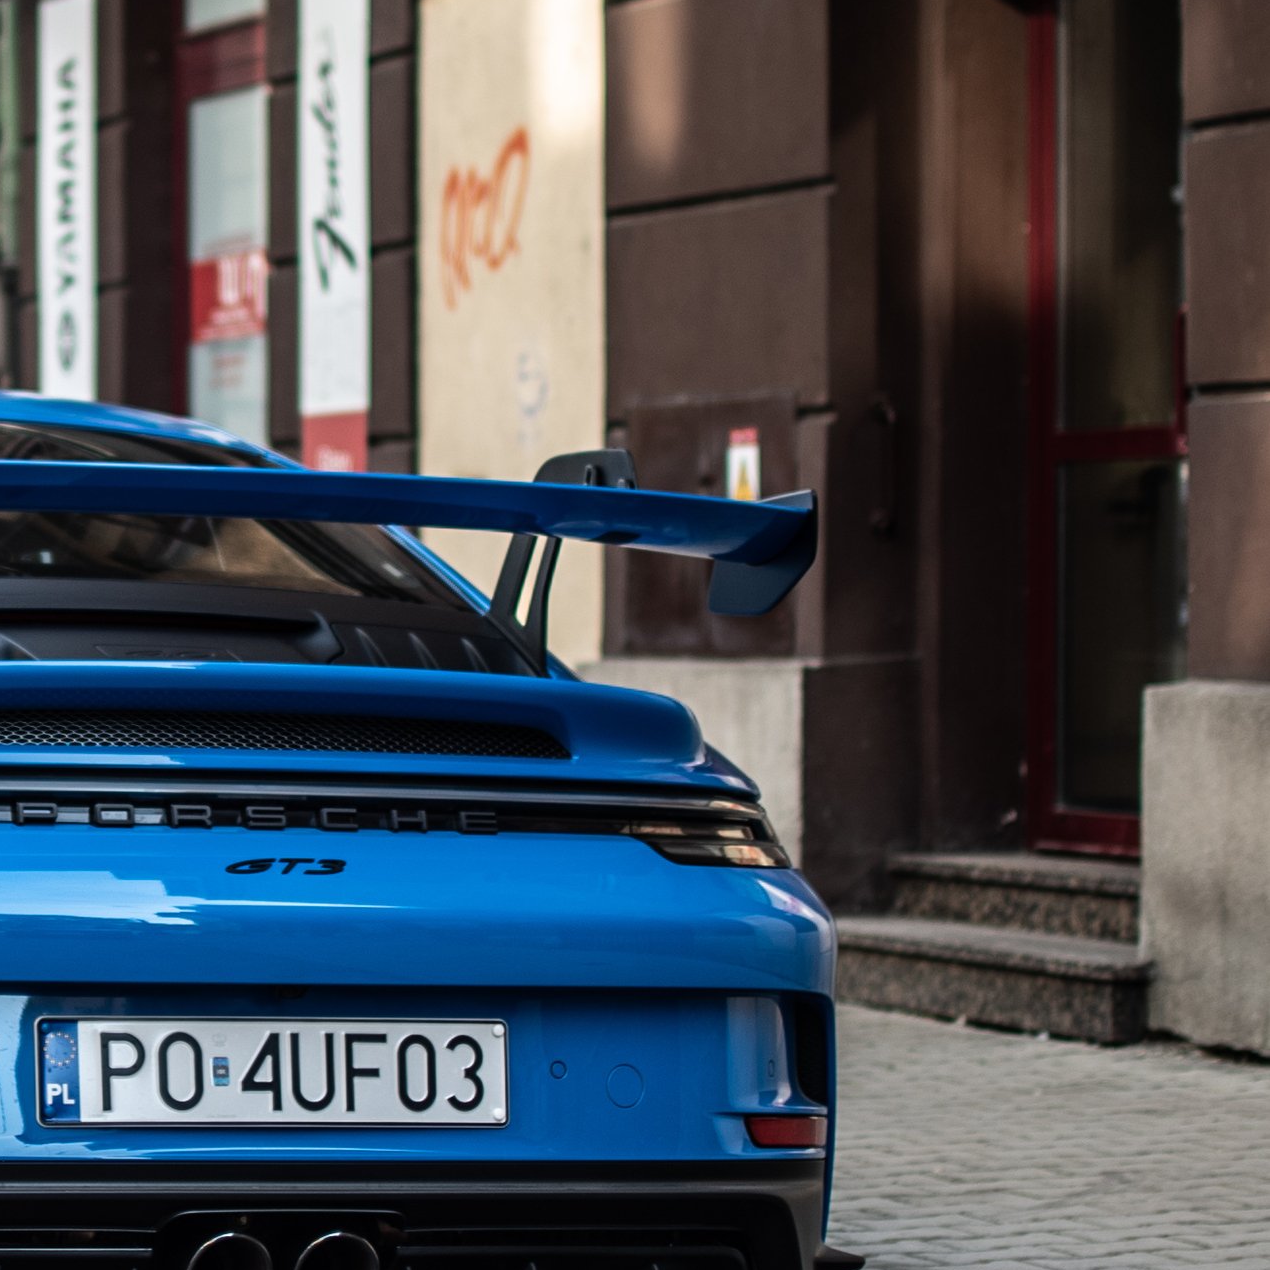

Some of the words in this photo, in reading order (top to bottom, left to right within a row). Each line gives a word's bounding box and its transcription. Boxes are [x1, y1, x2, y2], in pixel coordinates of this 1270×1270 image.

[55, 57, 77, 299] YAMAHA
[12, 800, 499, 834] PORSCHE
[224, 857, 347, 876] GT3
[240, 1030, 485, 1113] 4UF03
[45, 1082, 76, 1106] PL
